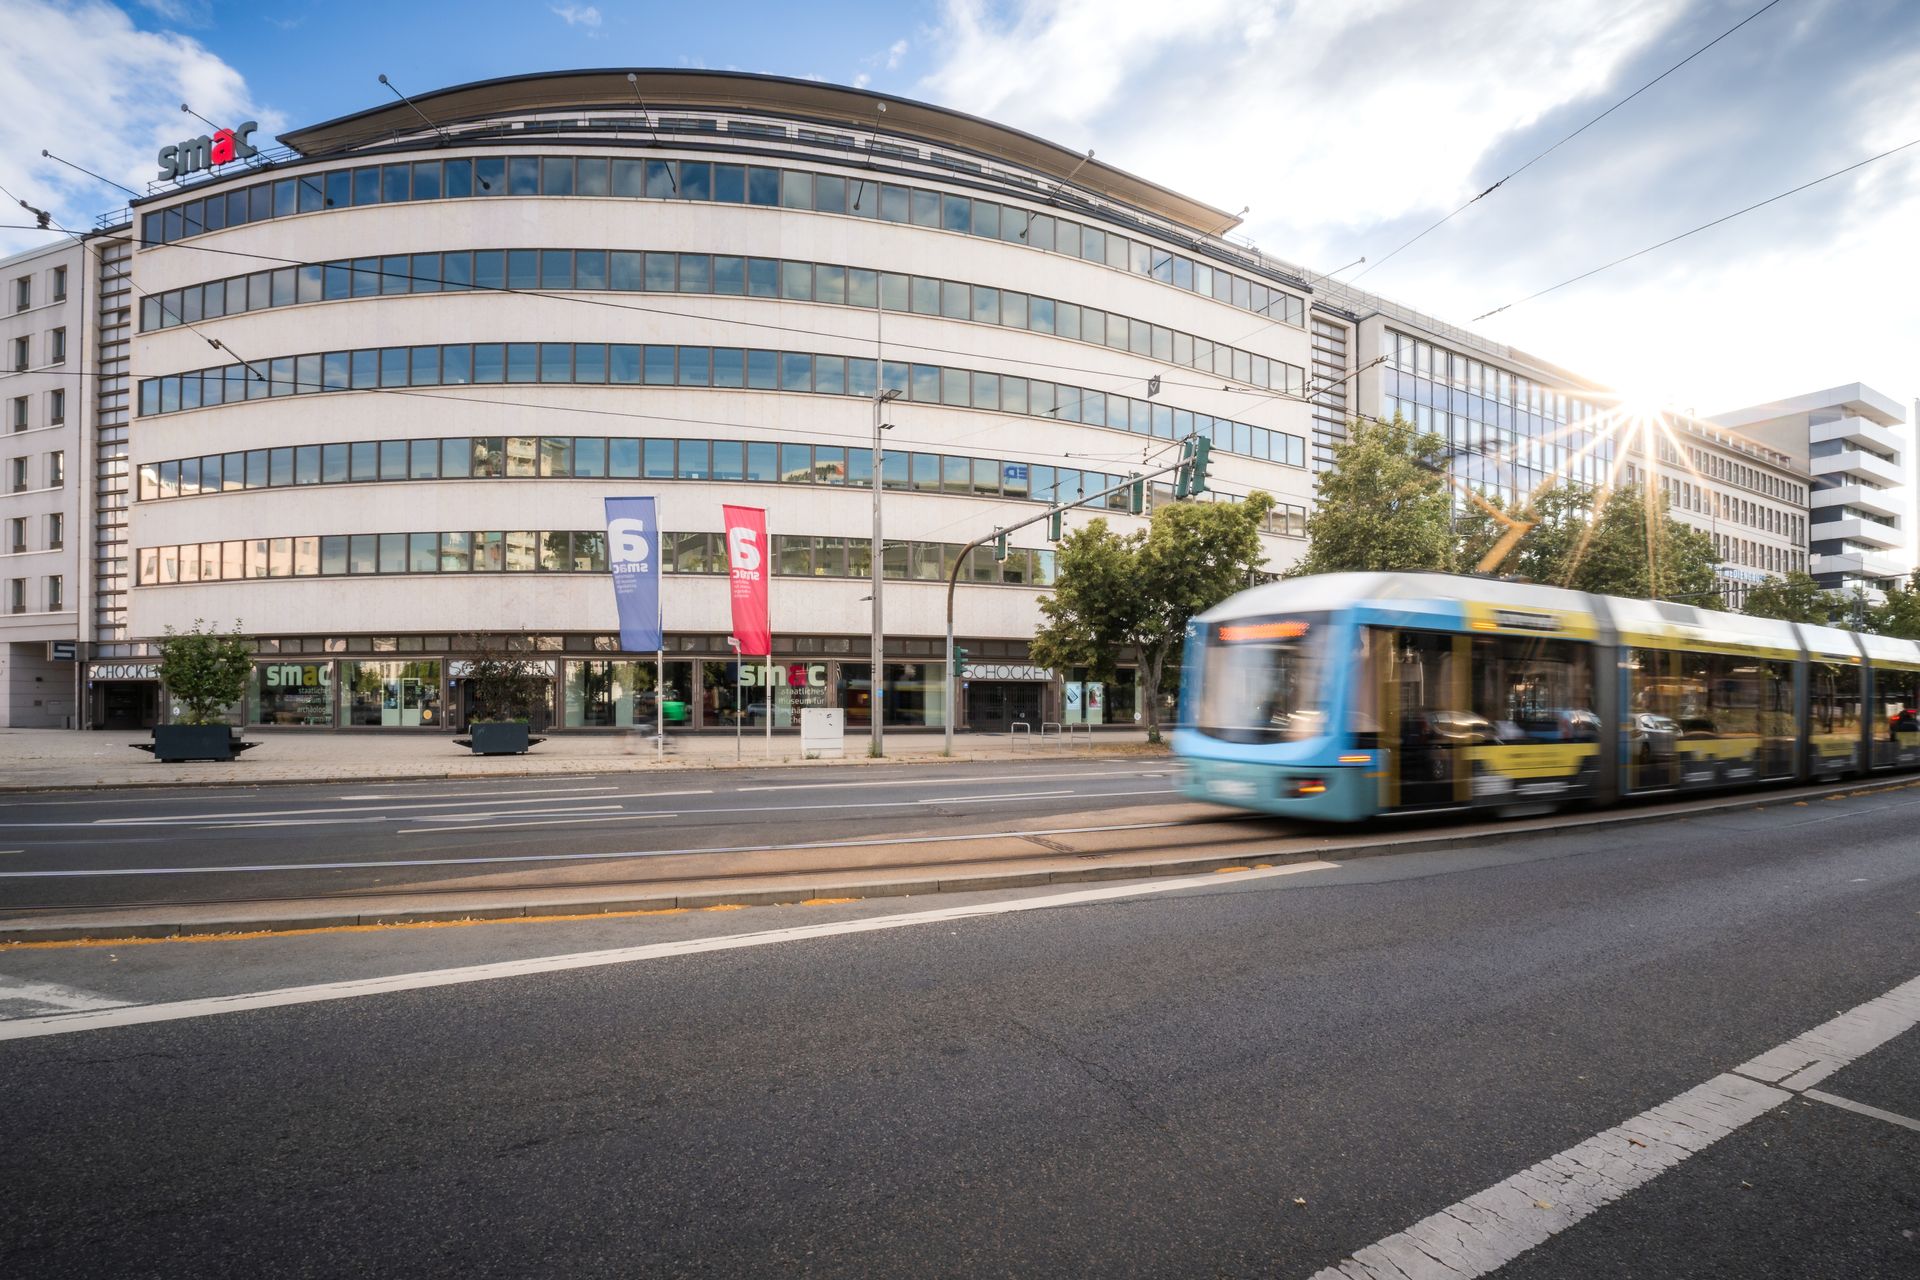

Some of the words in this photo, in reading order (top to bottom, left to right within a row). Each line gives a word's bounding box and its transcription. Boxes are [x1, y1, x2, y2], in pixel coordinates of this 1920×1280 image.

[158, 121, 258, 181] smac
[266, 665, 332, 686] smac
[739, 664, 826, 687] smac
[961, 664, 1054, 679] SCHOCKEN
